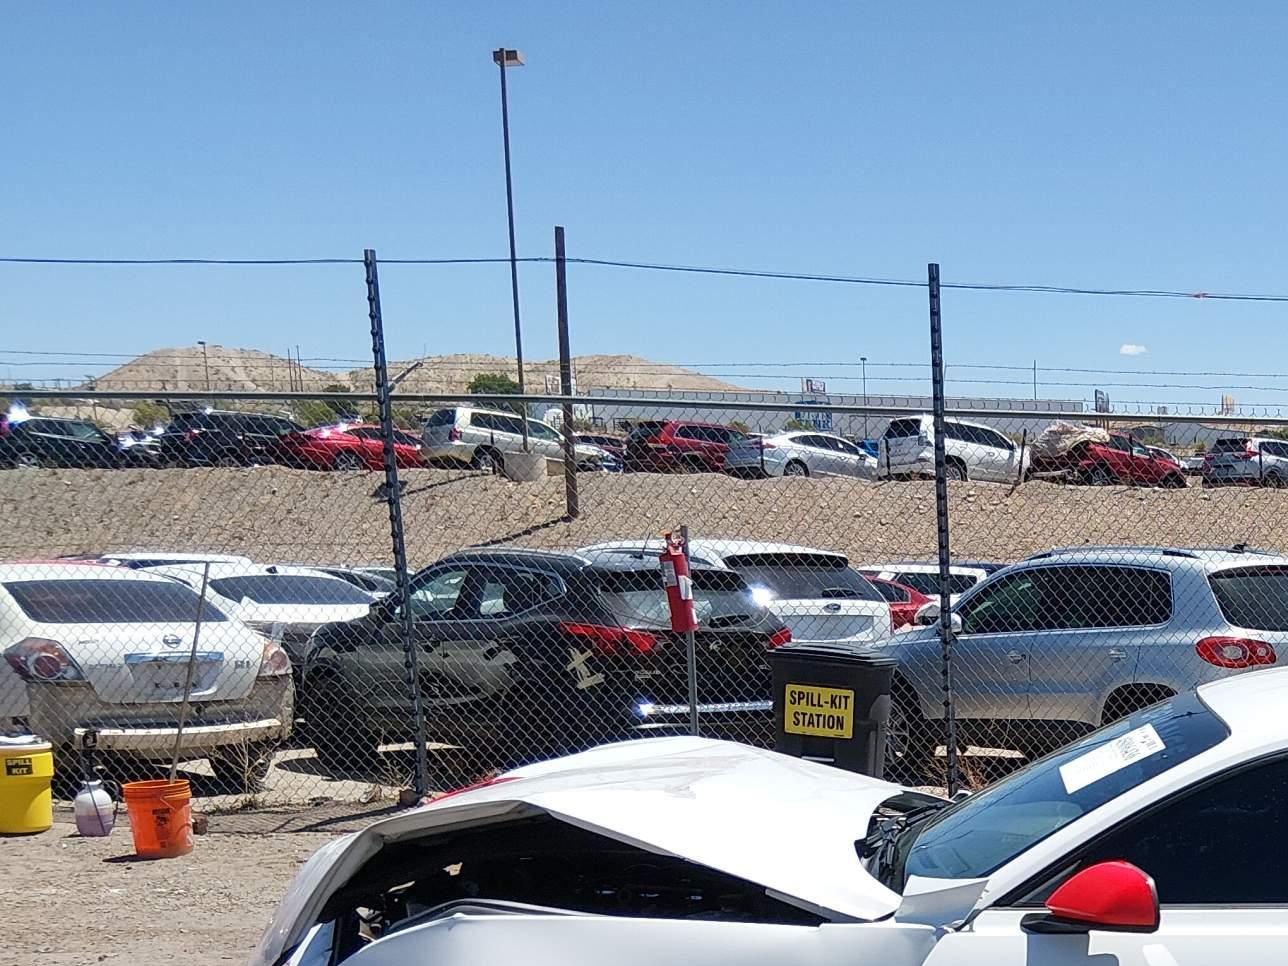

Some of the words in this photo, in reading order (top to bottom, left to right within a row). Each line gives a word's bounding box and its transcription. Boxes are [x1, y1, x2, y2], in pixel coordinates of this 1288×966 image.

[789, 689, 850, 710] SPILL-KIT
[792, 711, 844, 730] STATION
[12, 767, 29, 775] KIT
